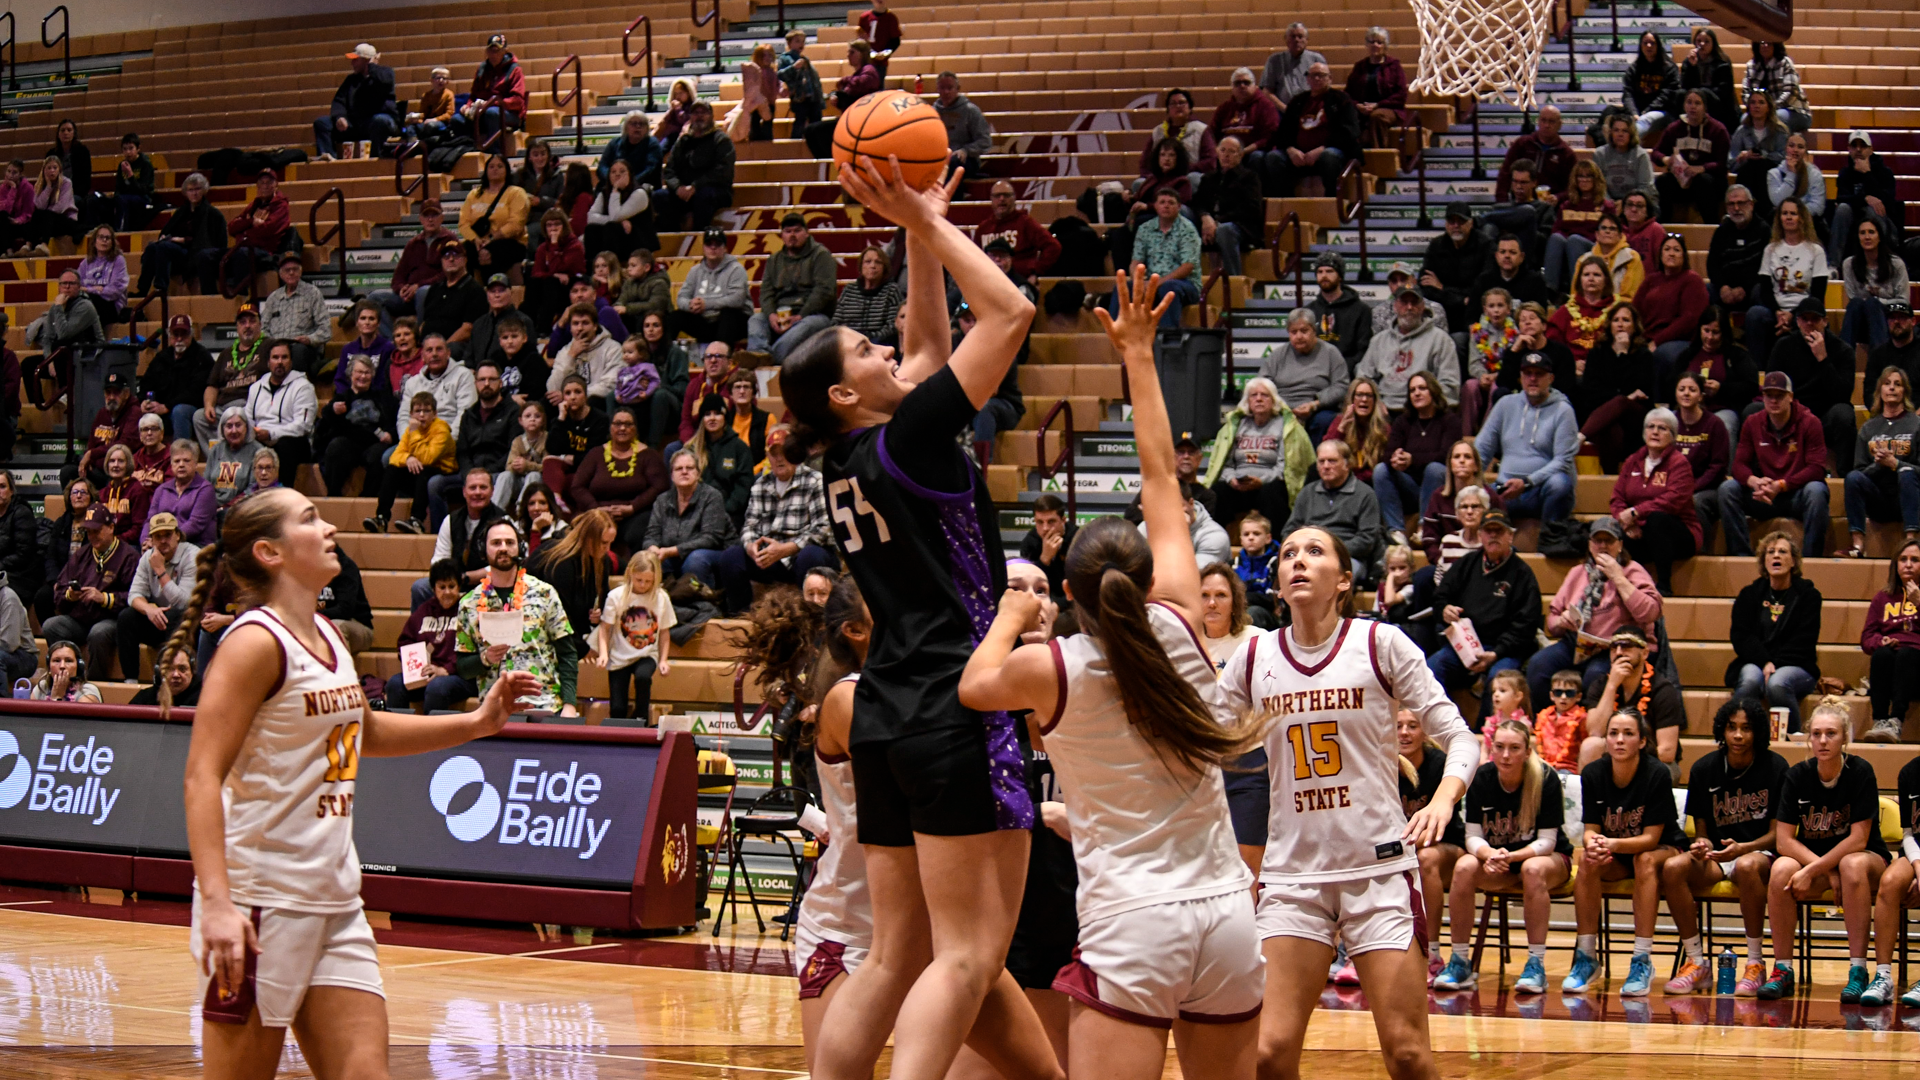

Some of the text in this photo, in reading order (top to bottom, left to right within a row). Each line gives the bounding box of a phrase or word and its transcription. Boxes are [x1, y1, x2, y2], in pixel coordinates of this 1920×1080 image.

[1244, 318, 1279, 327] STRONG.
[1098, 443, 1135, 453] STRONG.
[218, 461, 242, 483] N
[1061, 479, 1099, 488] ATEGRA
[828, 476, 892, 553] 54
[1261, 687, 1365, 715] NORTHERN
[709, 720, 742, 729] AGTEG
[37, 732, 114, 776] Eide
[1287, 721, 1344, 781] 15
[507, 758, 602, 805] Eide
[736, 767, 762, 778] ONG.
[28, 771, 121, 826] Bailly
[1294, 785, 1352, 813] STATE
[1713, 788, 1769, 819] Wolves
[498, 801, 612, 860] Bailly
[360, 863, 398, 872] KTRONICS
[758, 879, 794, 890] LOCAL.
